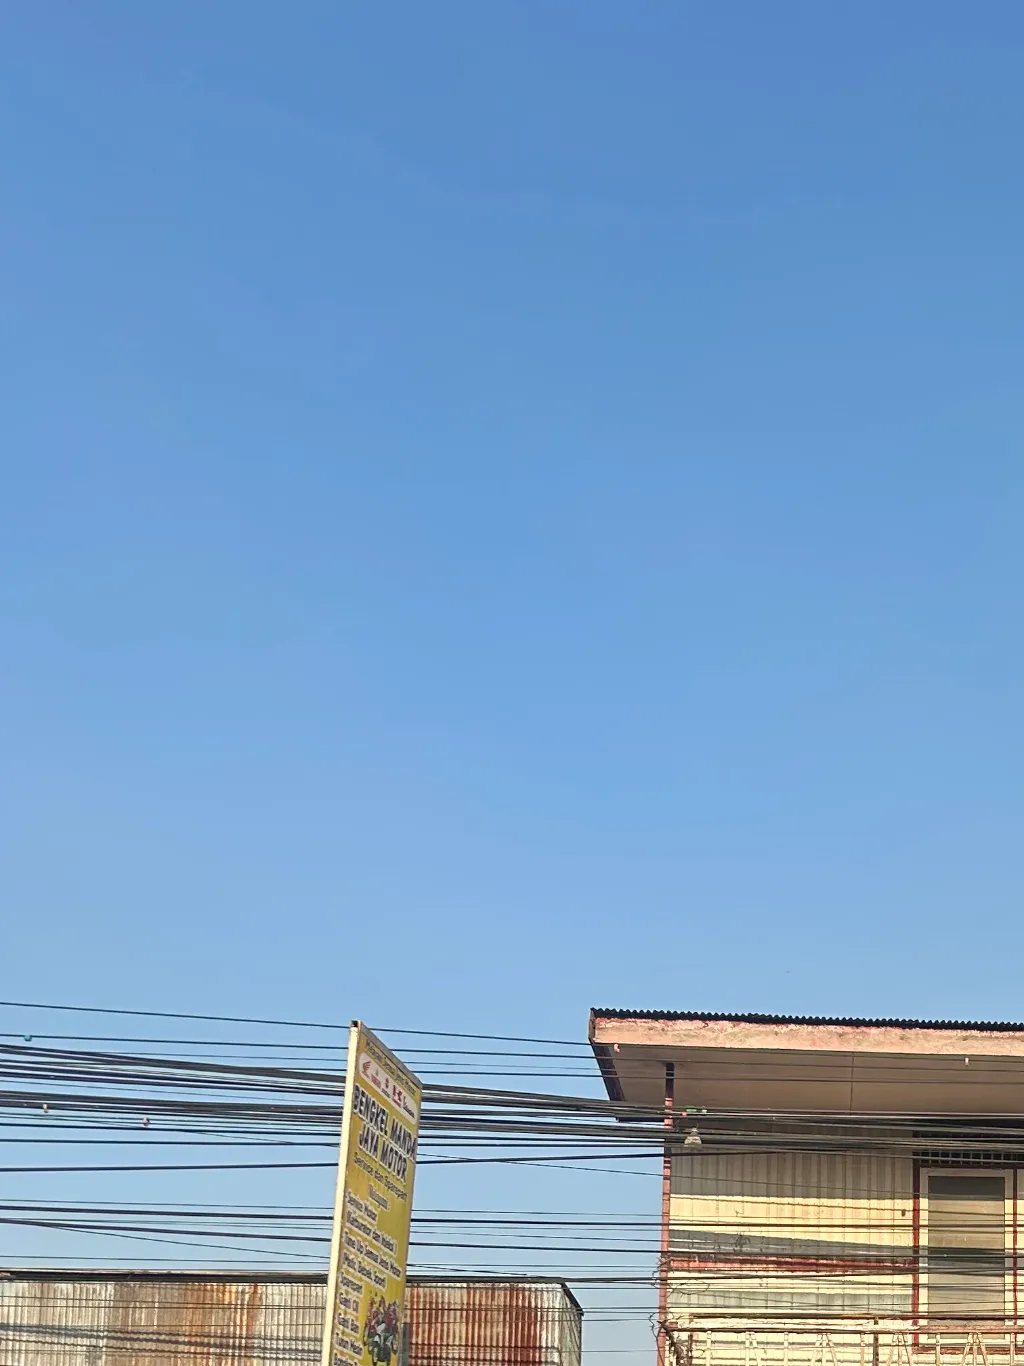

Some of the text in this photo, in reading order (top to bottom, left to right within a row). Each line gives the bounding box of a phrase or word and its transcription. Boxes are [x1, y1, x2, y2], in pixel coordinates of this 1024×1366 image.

[353, 1084, 389, 1136] BENGKEL
[389, 1116, 417, 1161] MANDA
[354, 1151, 373, 1176] Service
[374, 1169, 384, 1183] dan
[358, 1123, 408, 1184] JAYA MOTOR
[364, 1203, 377, 1222] Motor
